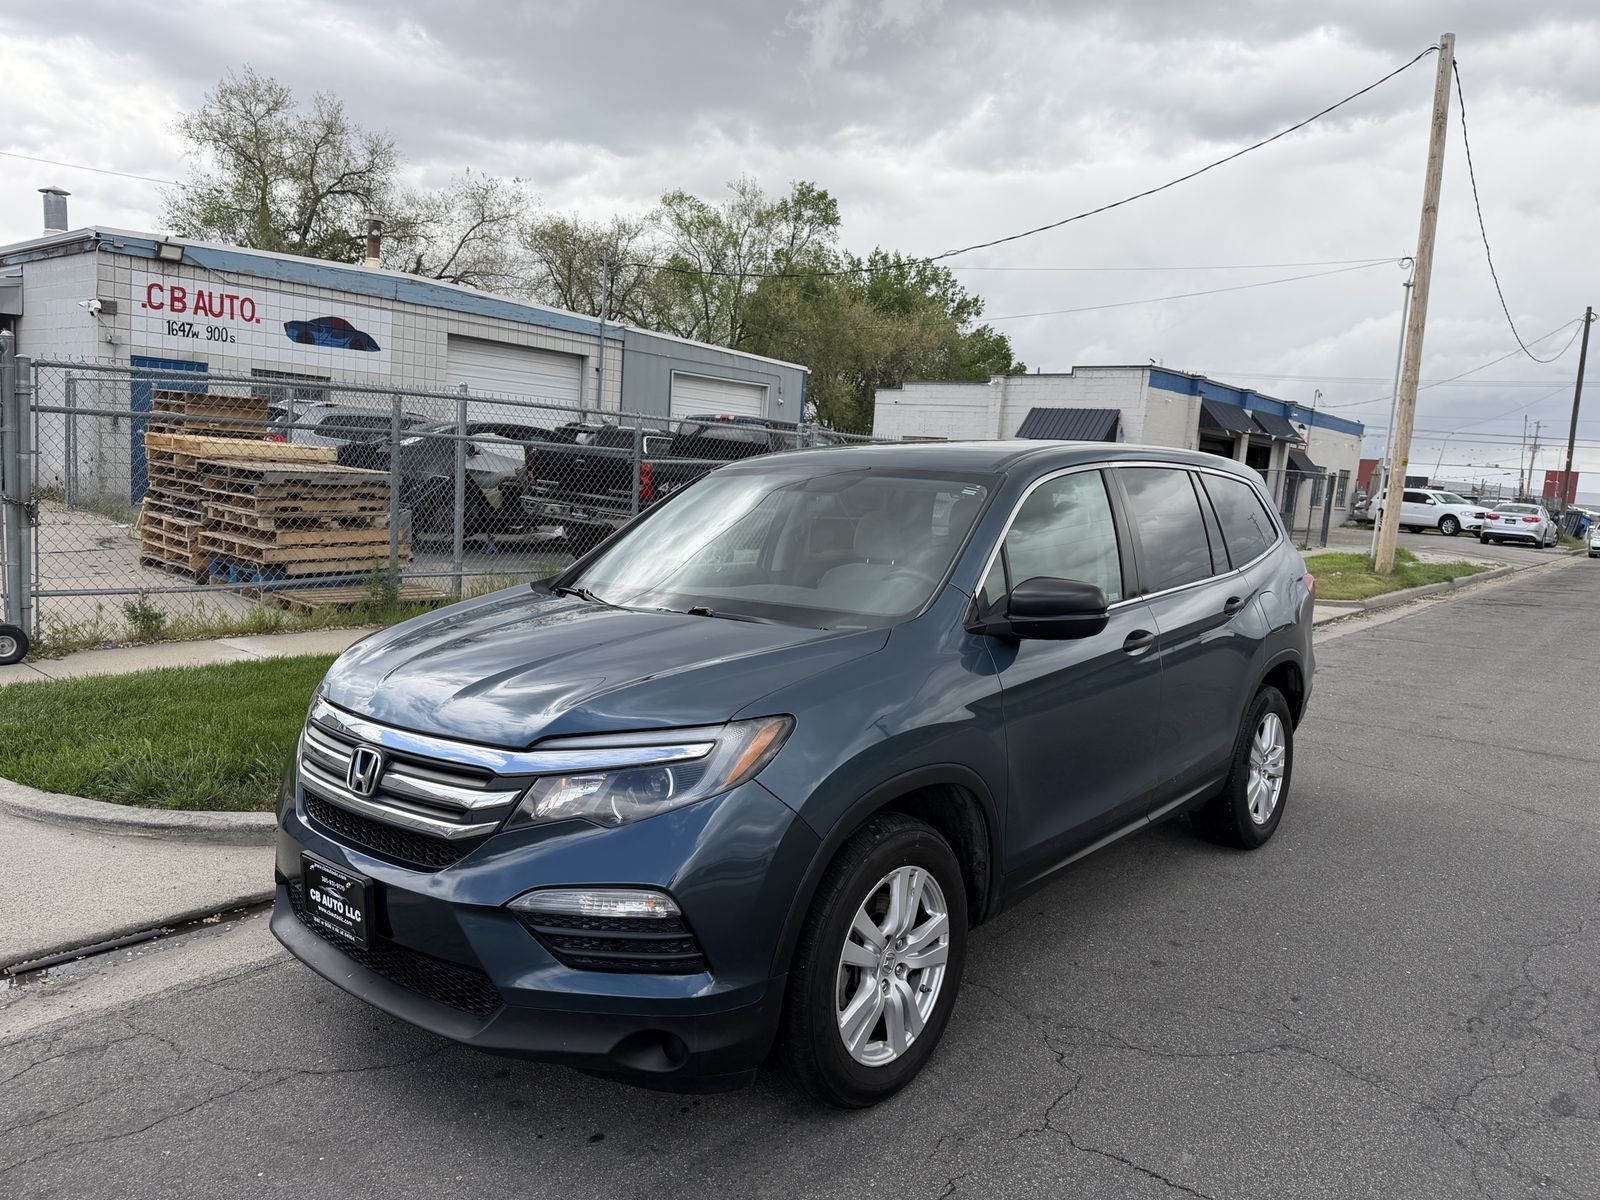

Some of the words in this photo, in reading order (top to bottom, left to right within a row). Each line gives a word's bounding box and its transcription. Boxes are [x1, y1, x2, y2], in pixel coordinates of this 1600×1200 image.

[310, 888, 321, 903] CB
[322, 894, 344, 914] AUTO
[345, 905, 361, 922] LLC
